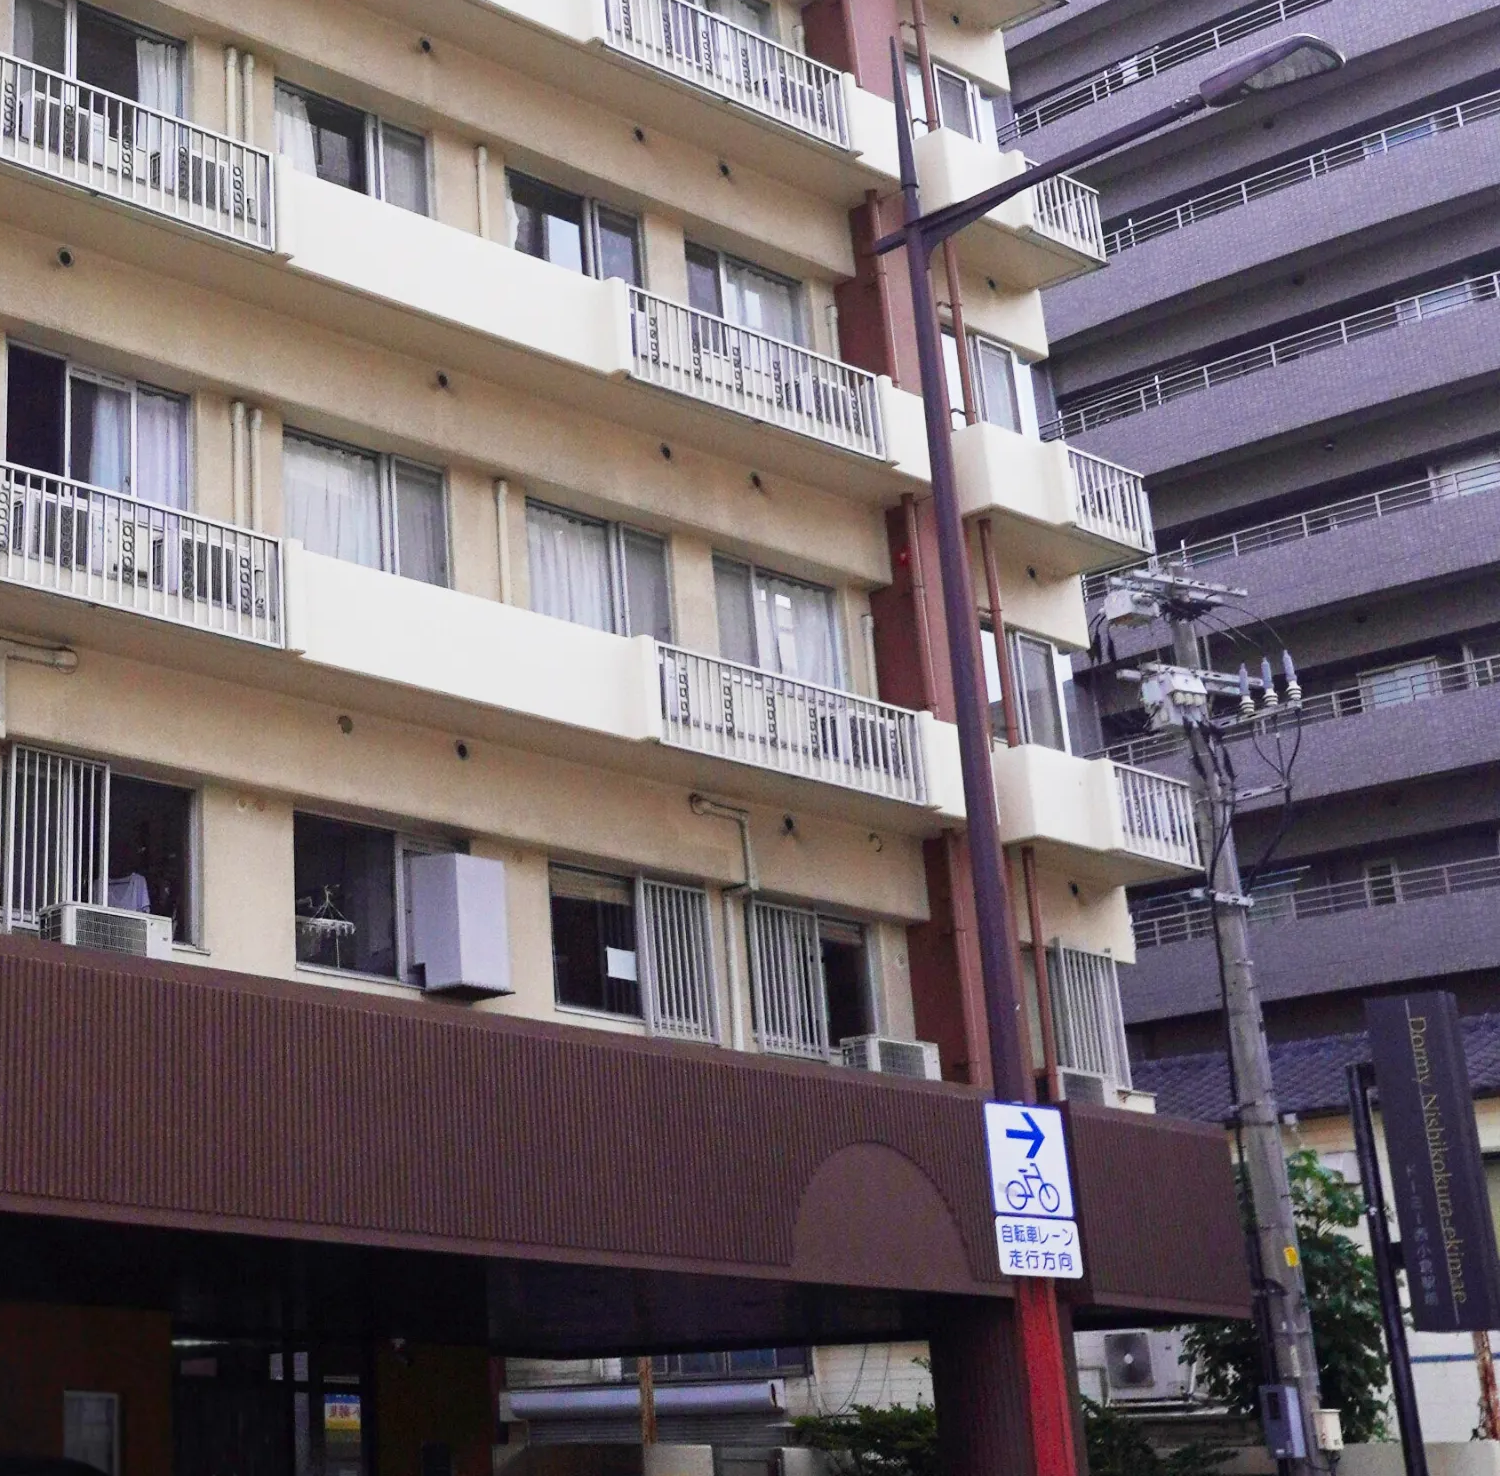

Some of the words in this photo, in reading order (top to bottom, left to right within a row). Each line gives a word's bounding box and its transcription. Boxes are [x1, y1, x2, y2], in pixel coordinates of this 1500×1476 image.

[1408, 1016, 1432, 1086] Dormy
[1001, 1224, 1073, 1246] 自転車レーン
[1009, 1249, 1073, 1271] 走行方向
